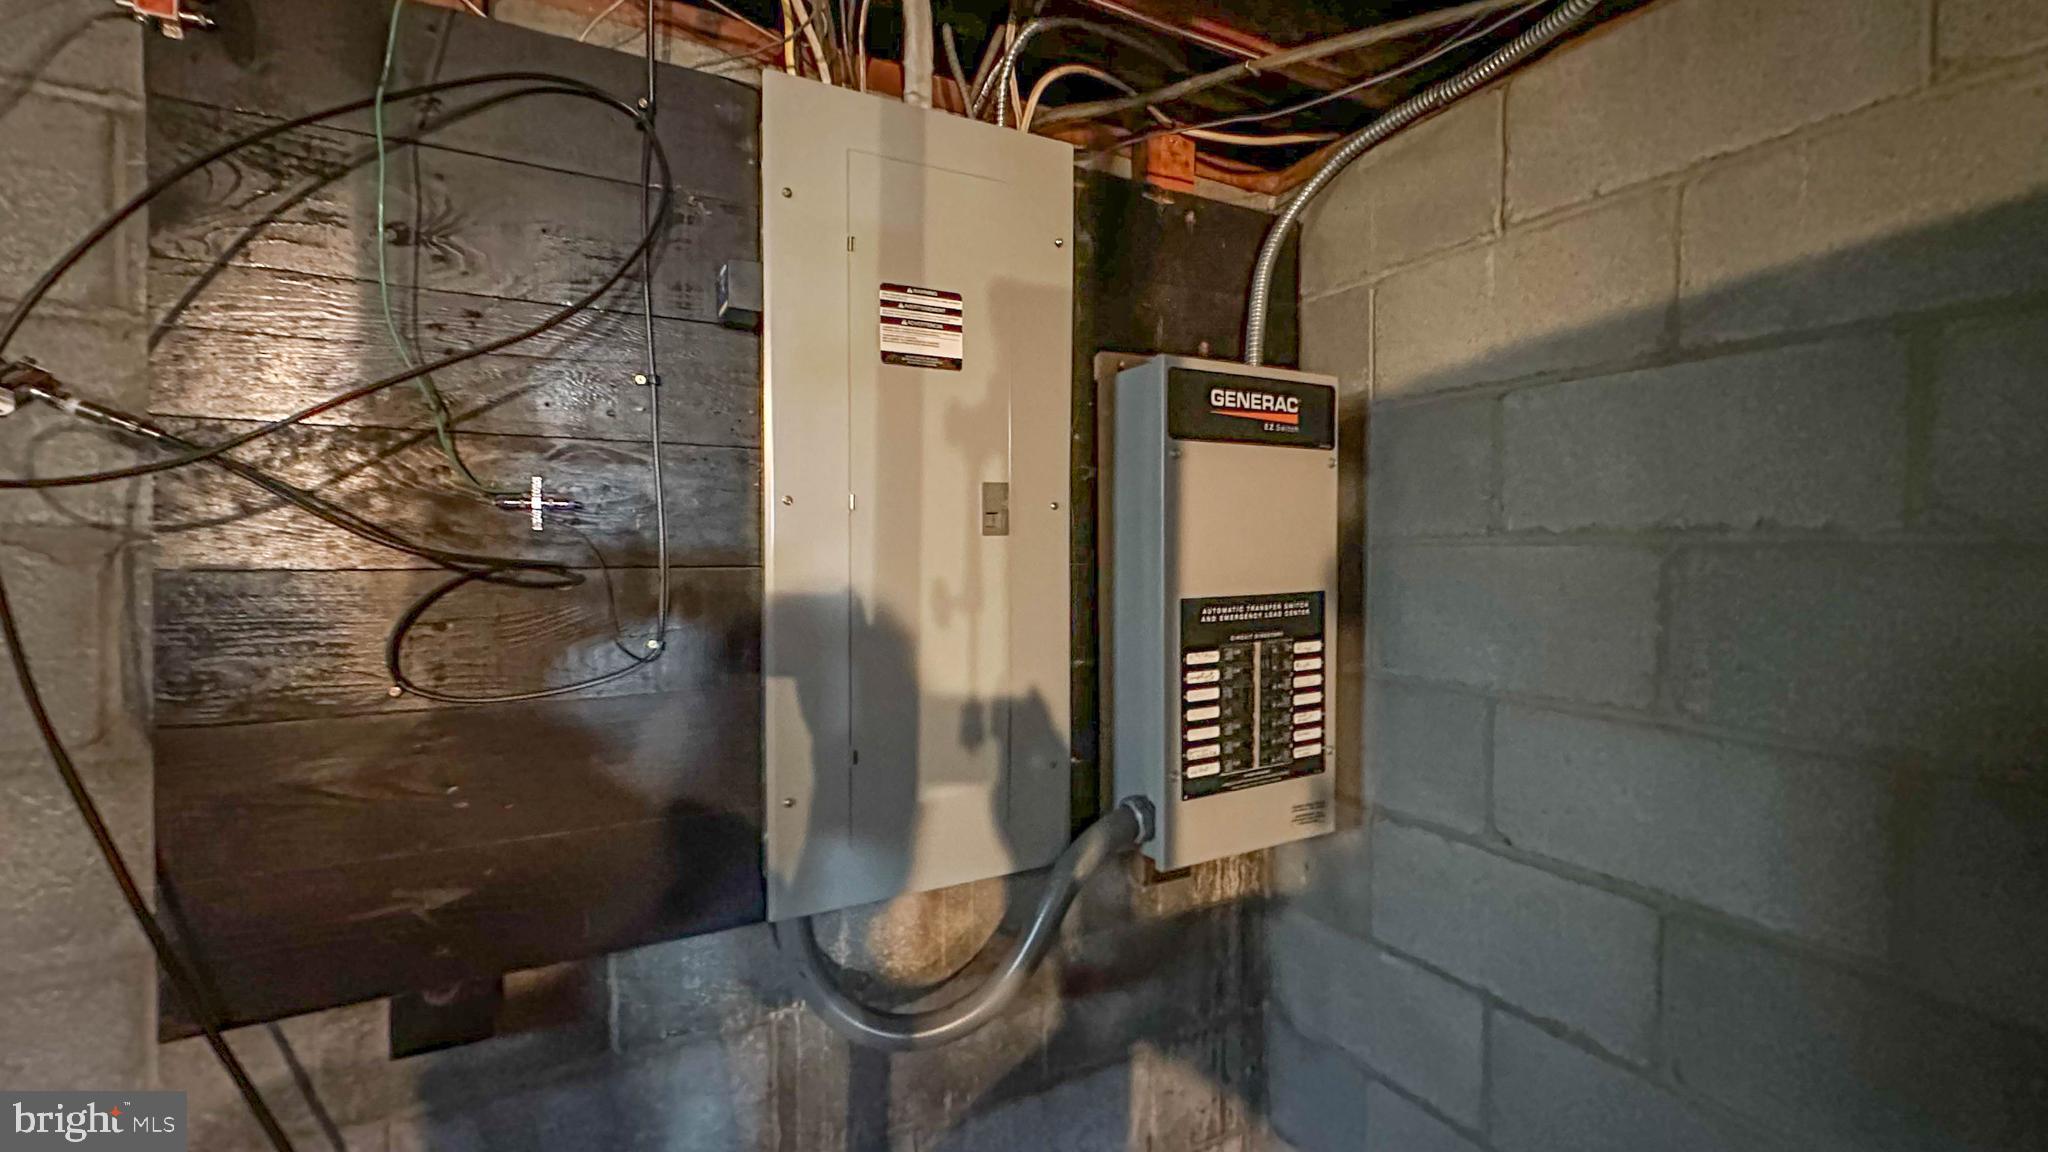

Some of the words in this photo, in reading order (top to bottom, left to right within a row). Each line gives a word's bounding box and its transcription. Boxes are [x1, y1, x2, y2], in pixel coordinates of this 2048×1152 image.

[1210, 389, 1299, 413] GENERAC
[1264, 423, 1274, 431] EZ
[1202, 605, 1244, 615] AUTOMATIC
[1246, 603, 1282, 612] TRANSFER
[1284, 601, 1309, 610] SWITCH
[1200, 615, 1217, 623] AND
[1219, 612, 1263, 622] EMERGENCY
[1264, 610, 1282, 619] LOAD
[1284, 608, 1310, 617] CENTER
